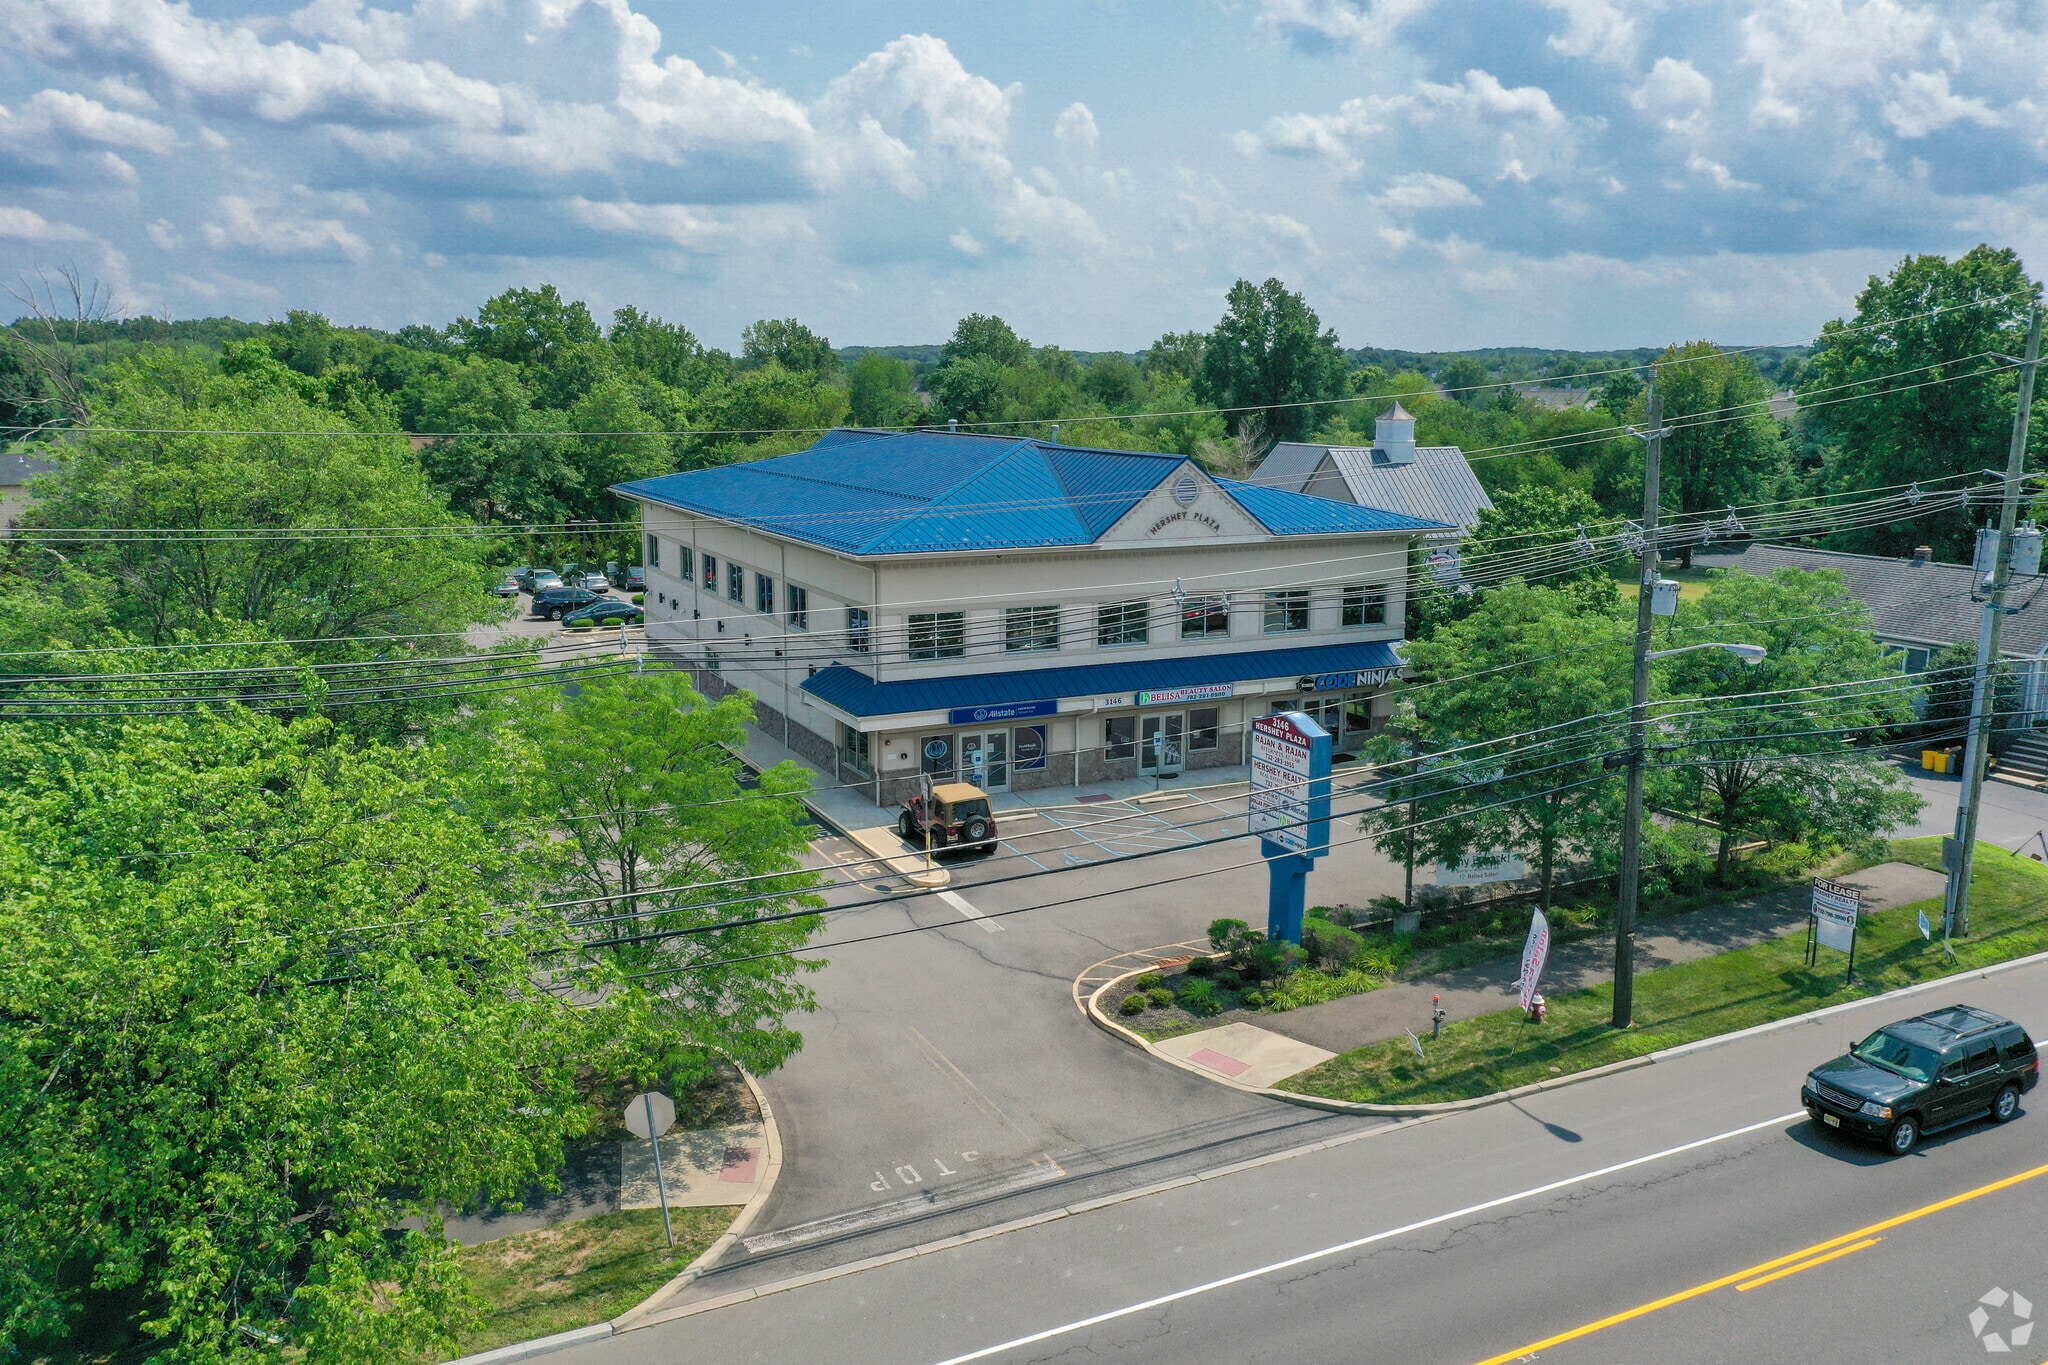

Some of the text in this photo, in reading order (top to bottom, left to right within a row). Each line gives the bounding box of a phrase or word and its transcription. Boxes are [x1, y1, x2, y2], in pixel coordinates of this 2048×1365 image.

[1150, 511, 1220, 535] HERSHEY PLAZA
[1315, 668, 1404, 691] CODE NINJAS
[1150, 684, 1232, 702] BELISA BEAUTY SALON
[987, 708, 1016, 718] Allstate
[1255, 721, 1307, 746] HERSHEY PLAZA
[1272, 717, 1289, 731] 3146
[1255, 734, 1307, 760] RAJAN & RAJAN
[1254, 760, 1281, 778] HERSHEY
[1814, 879, 1859, 899] FOR LEASE
[1834, 894, 1857, 906] REALTY
